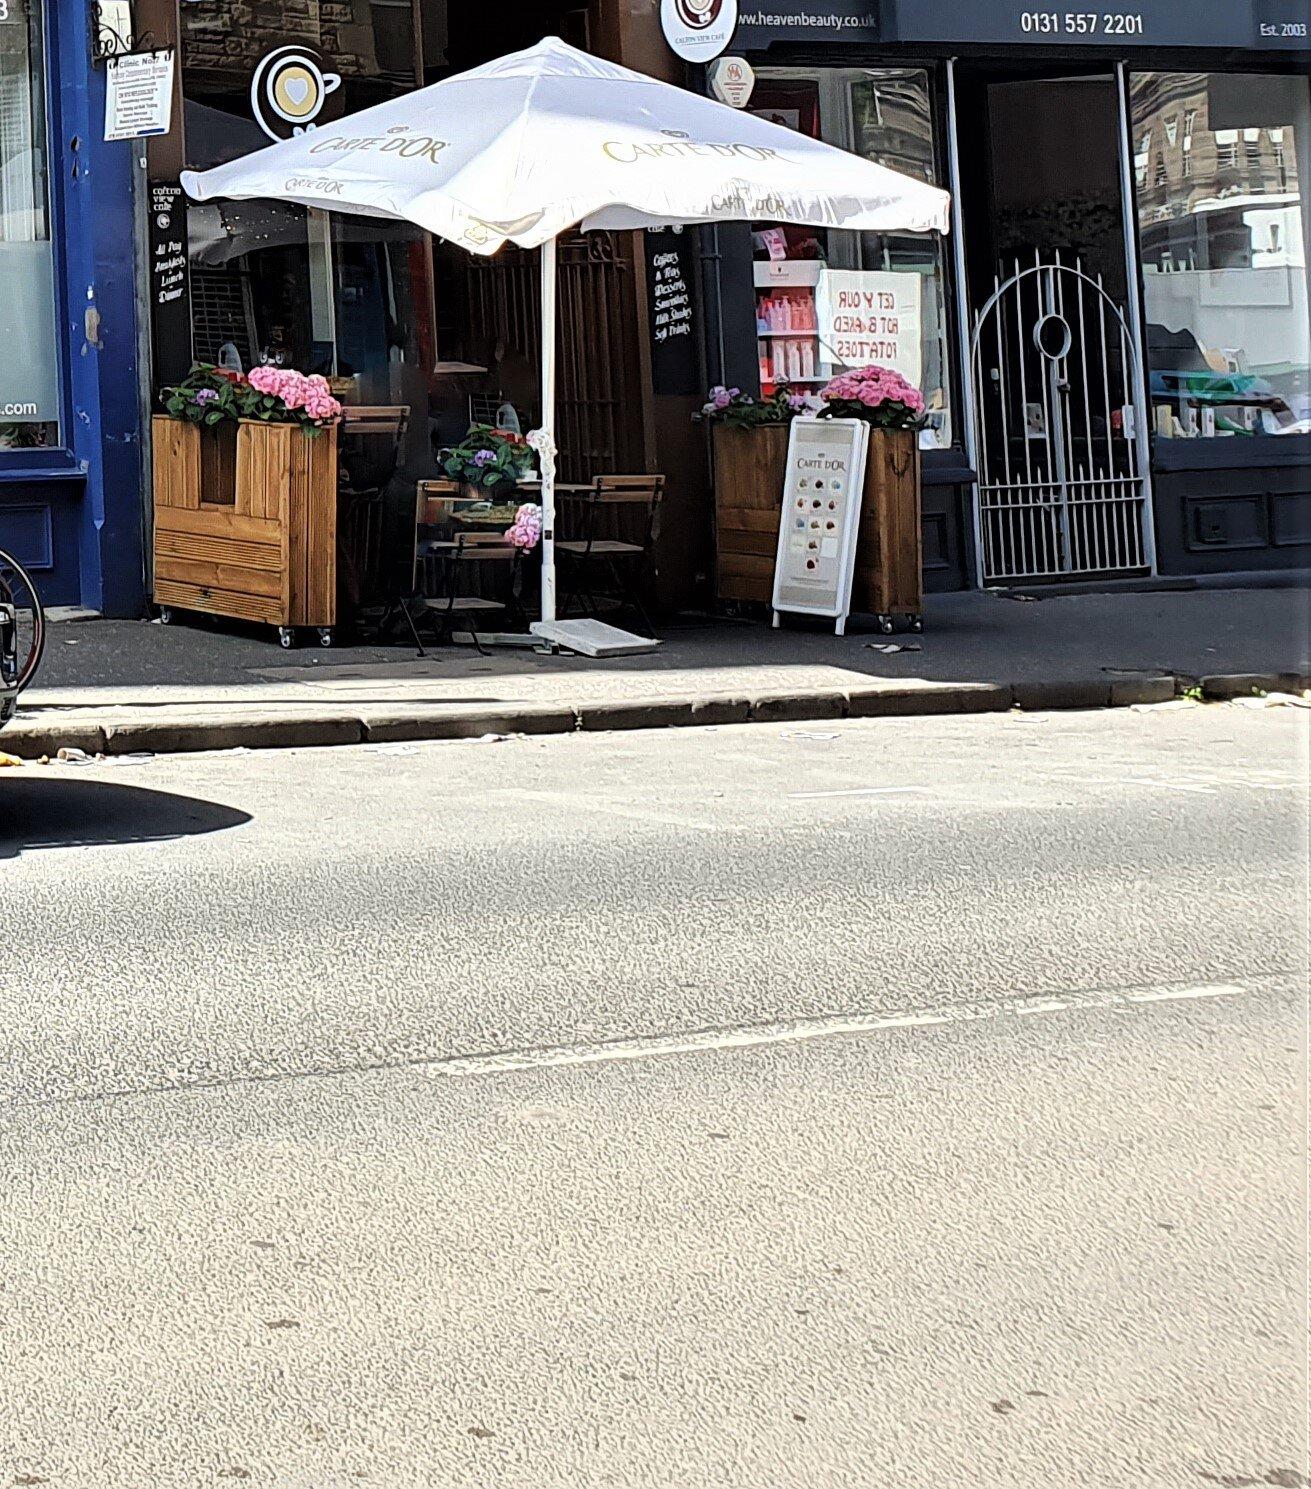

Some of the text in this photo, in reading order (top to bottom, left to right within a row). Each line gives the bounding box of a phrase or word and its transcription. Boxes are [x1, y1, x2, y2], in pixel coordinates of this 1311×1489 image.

[738, 11, 876, 31] ww.heavenbeauty.co.uk
[1021, 12, 1143, 34] 0131 557 2201
[1281, 22, 1307, 37] 2003
[310, 137, 447, 164] CARTE D'OR
[602, 141, 803, 164] CARTE D'OR
[711, 195, 746, 212] CART
[797, 457, 847, 472] CARTE D'OR
